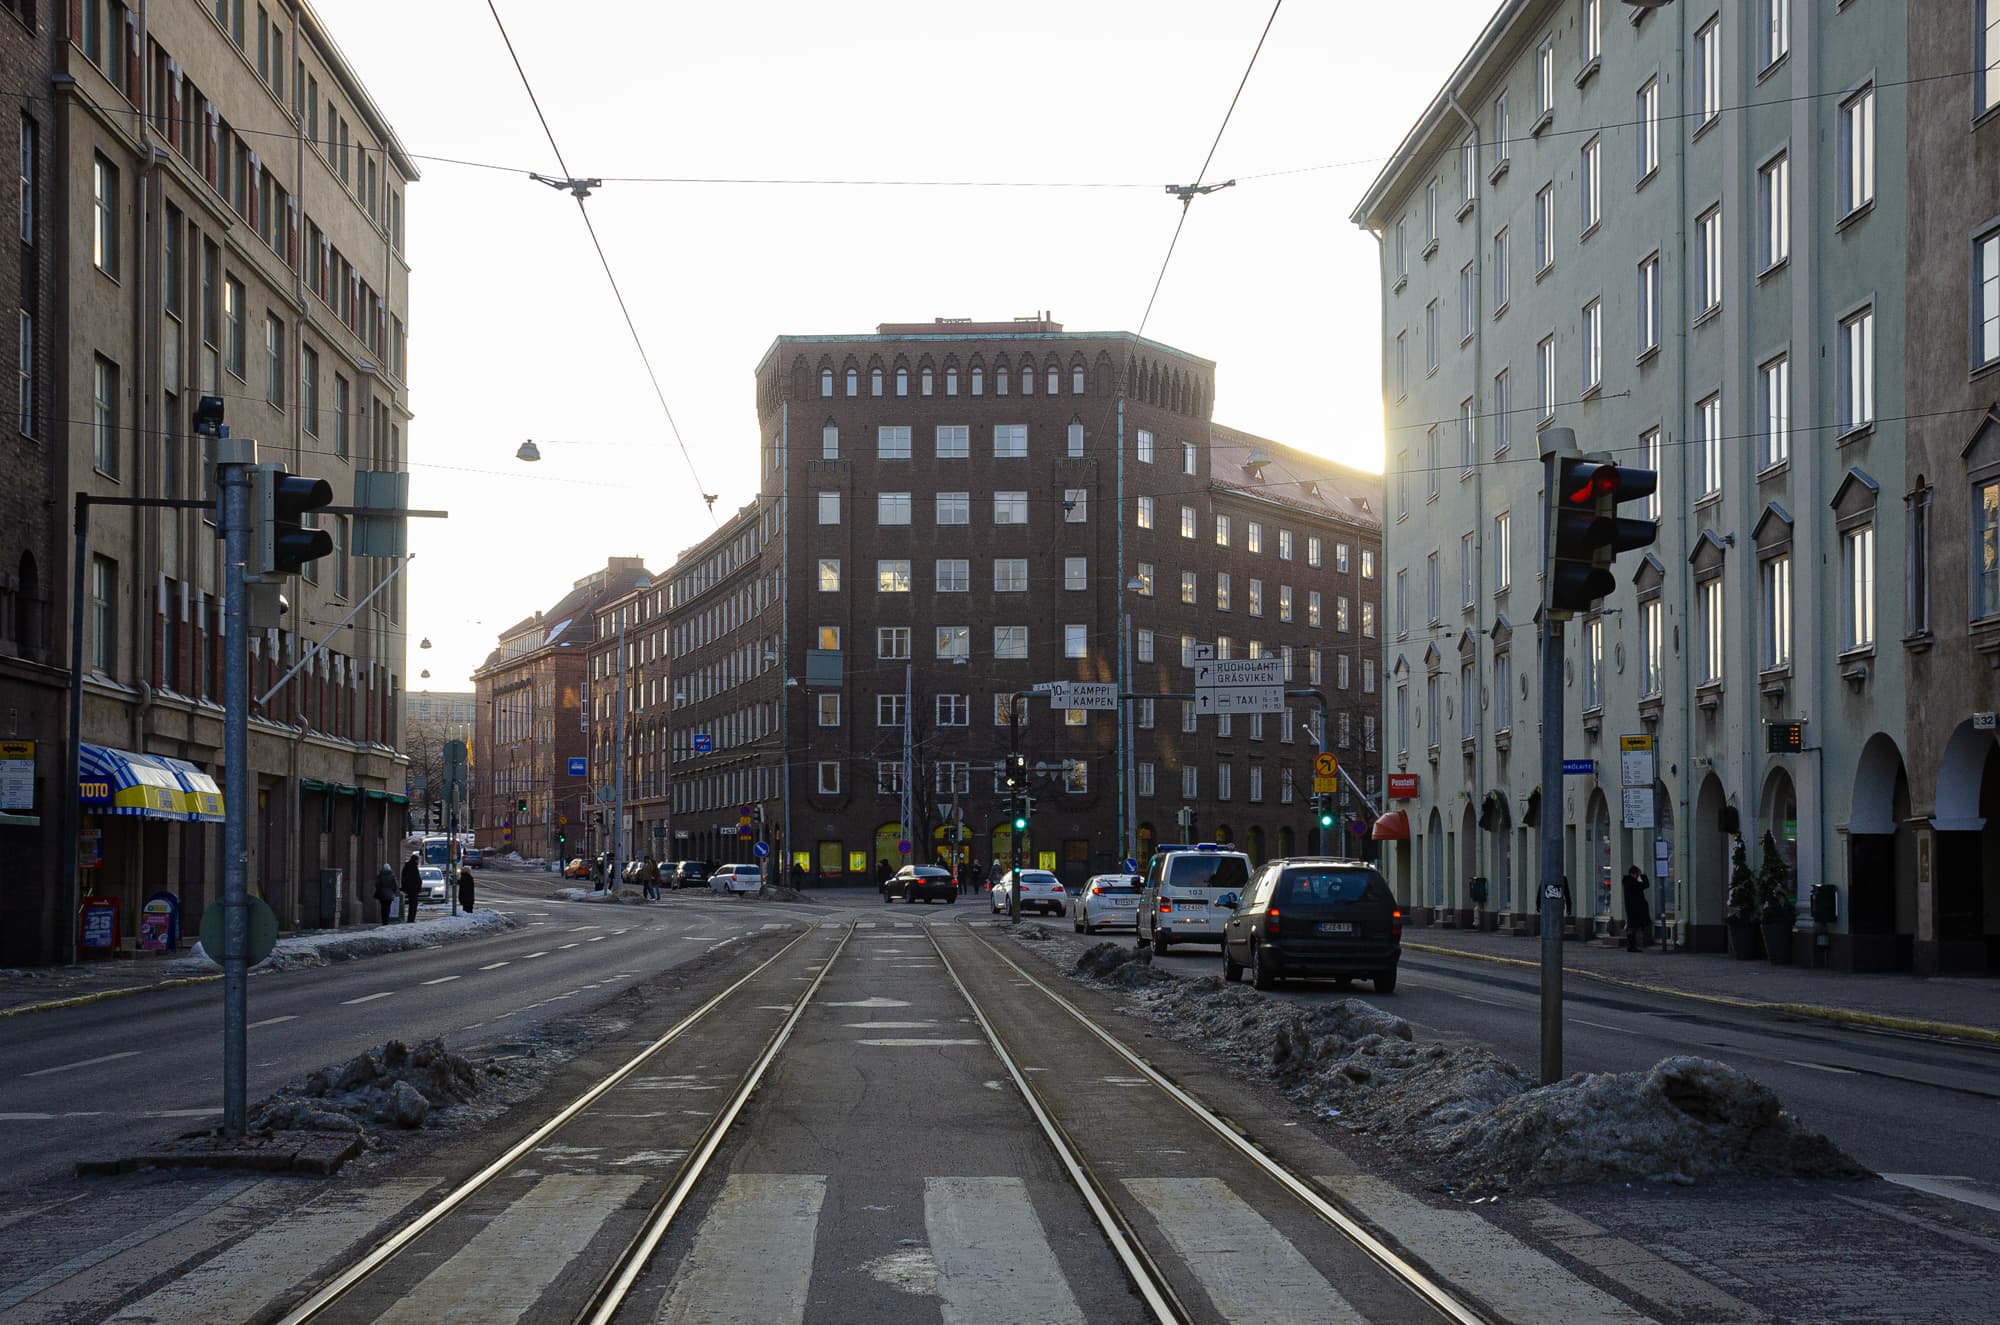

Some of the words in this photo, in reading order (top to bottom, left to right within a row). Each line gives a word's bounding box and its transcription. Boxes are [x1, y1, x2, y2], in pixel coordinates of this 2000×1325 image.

[1217, 662, 1278, 673] RUOHOLAHTI
[1217, 673, 1274, 683] GRÄSVIKEN
[1073, 686, 1110, 696] KAMPPI
[1073, 697, 1114, 706] KAMPEN
[1236, 695, 1258, 705] TAXI
[1980, 715, 1994, 726] 32
[80, 783, 109, 797] TOTO
